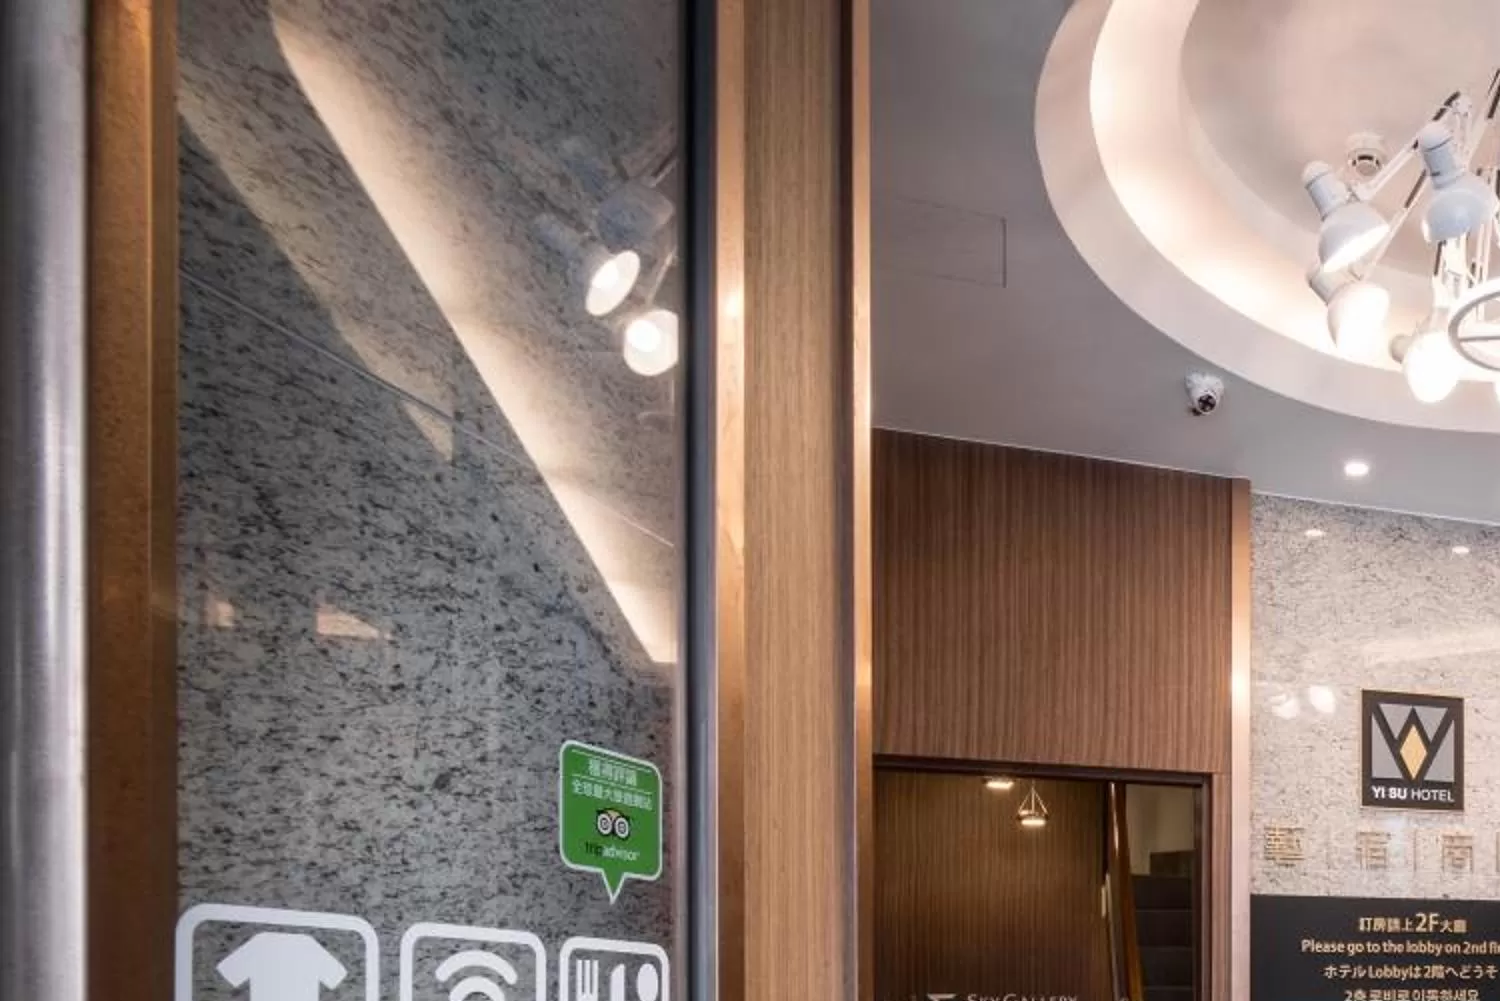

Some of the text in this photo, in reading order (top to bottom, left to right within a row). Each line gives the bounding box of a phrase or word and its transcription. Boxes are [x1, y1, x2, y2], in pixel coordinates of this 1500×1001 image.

[1371, 785, 1386, 799] YI
[1411, 788, 1456, 803] HOTEL
[1301, 939, 1345, 954] Please
[1347, 942, 1365, 956] go
[1367, 940, 1381, 953] to
[1383, 939, 1404, 954] the
[1406, 939, 1442, 956] lobby
[1447, 943, 1462, 954] on
[1464, 940, 1488, 955] 2nd
